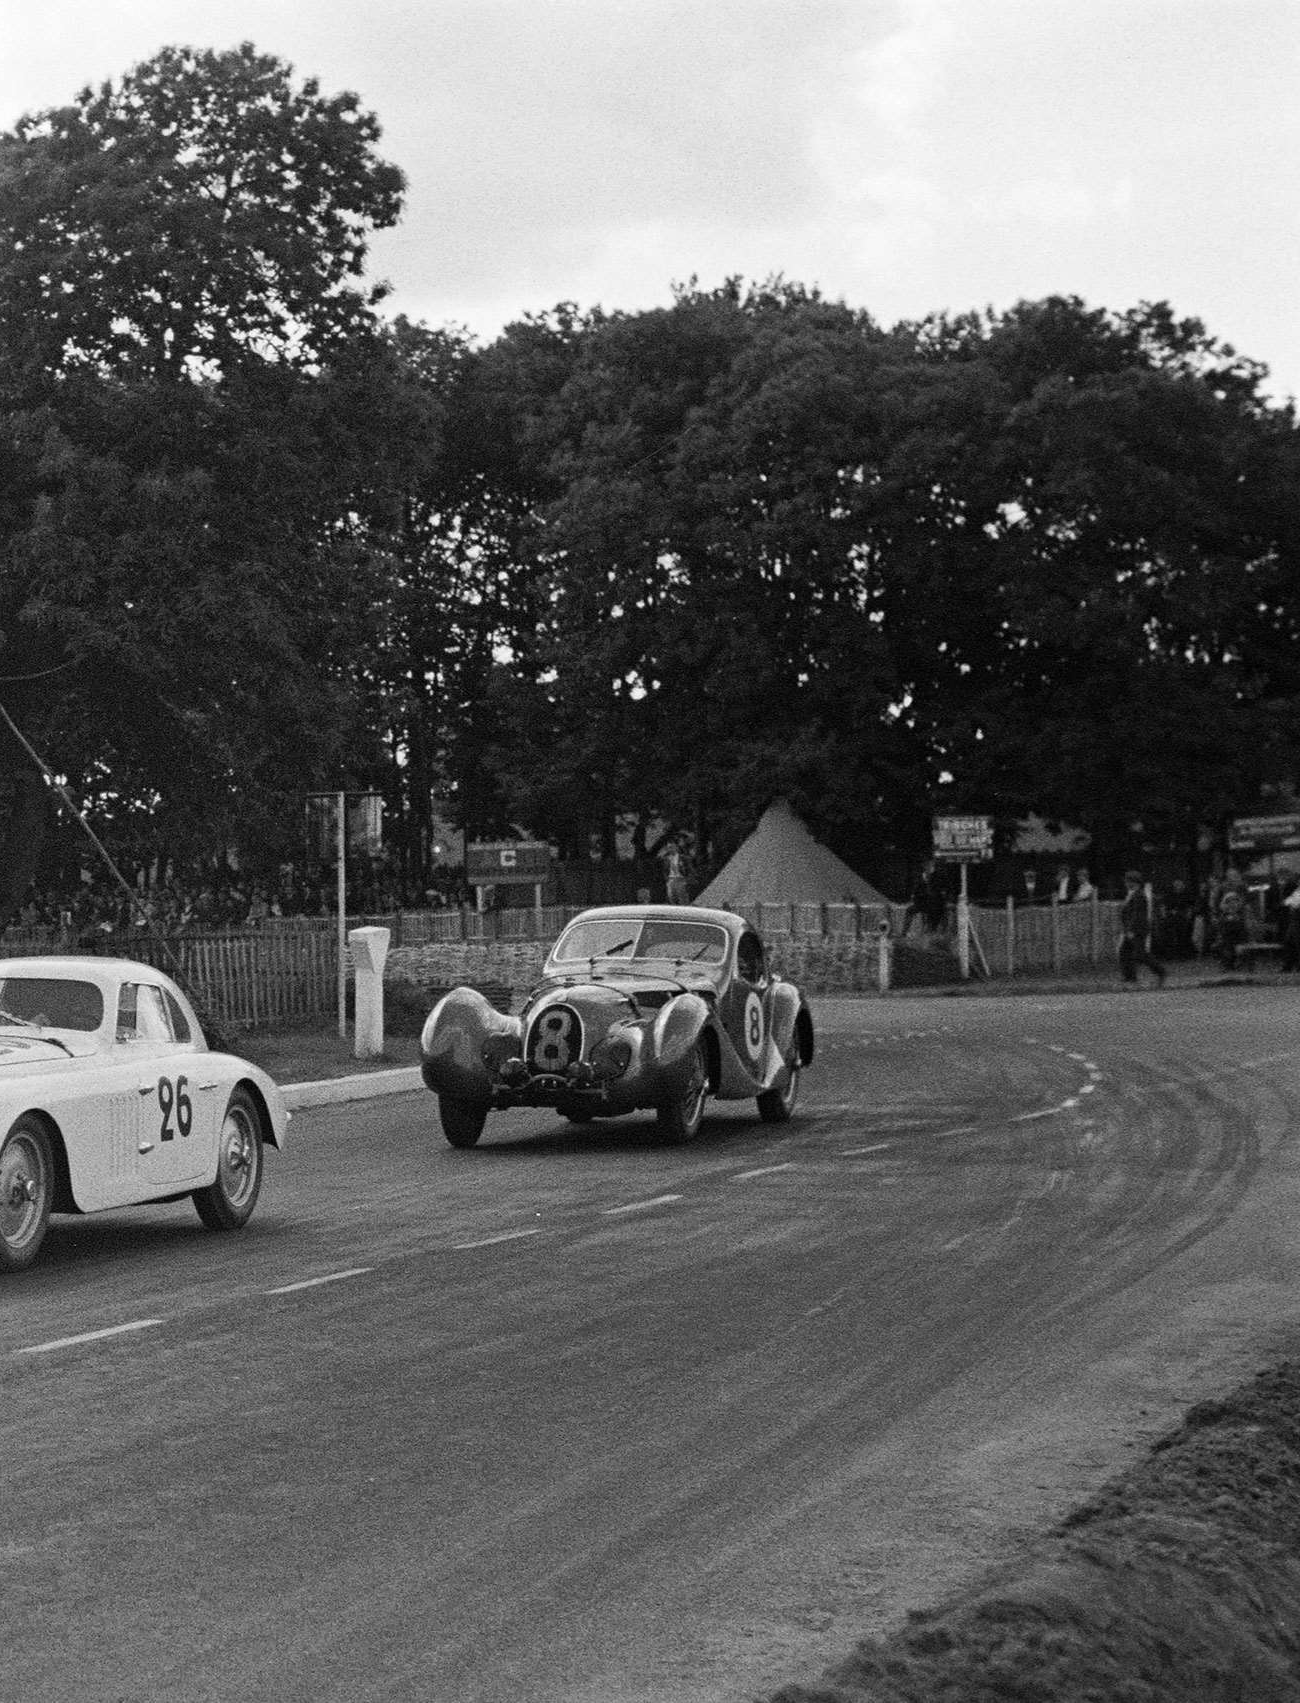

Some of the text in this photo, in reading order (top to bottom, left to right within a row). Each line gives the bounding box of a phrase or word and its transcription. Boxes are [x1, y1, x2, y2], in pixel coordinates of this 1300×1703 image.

[534, 1010, 572, 1071] 8
[749, 1005, 760, 1047] 8
[158, 1074, 192, 1142] 26
